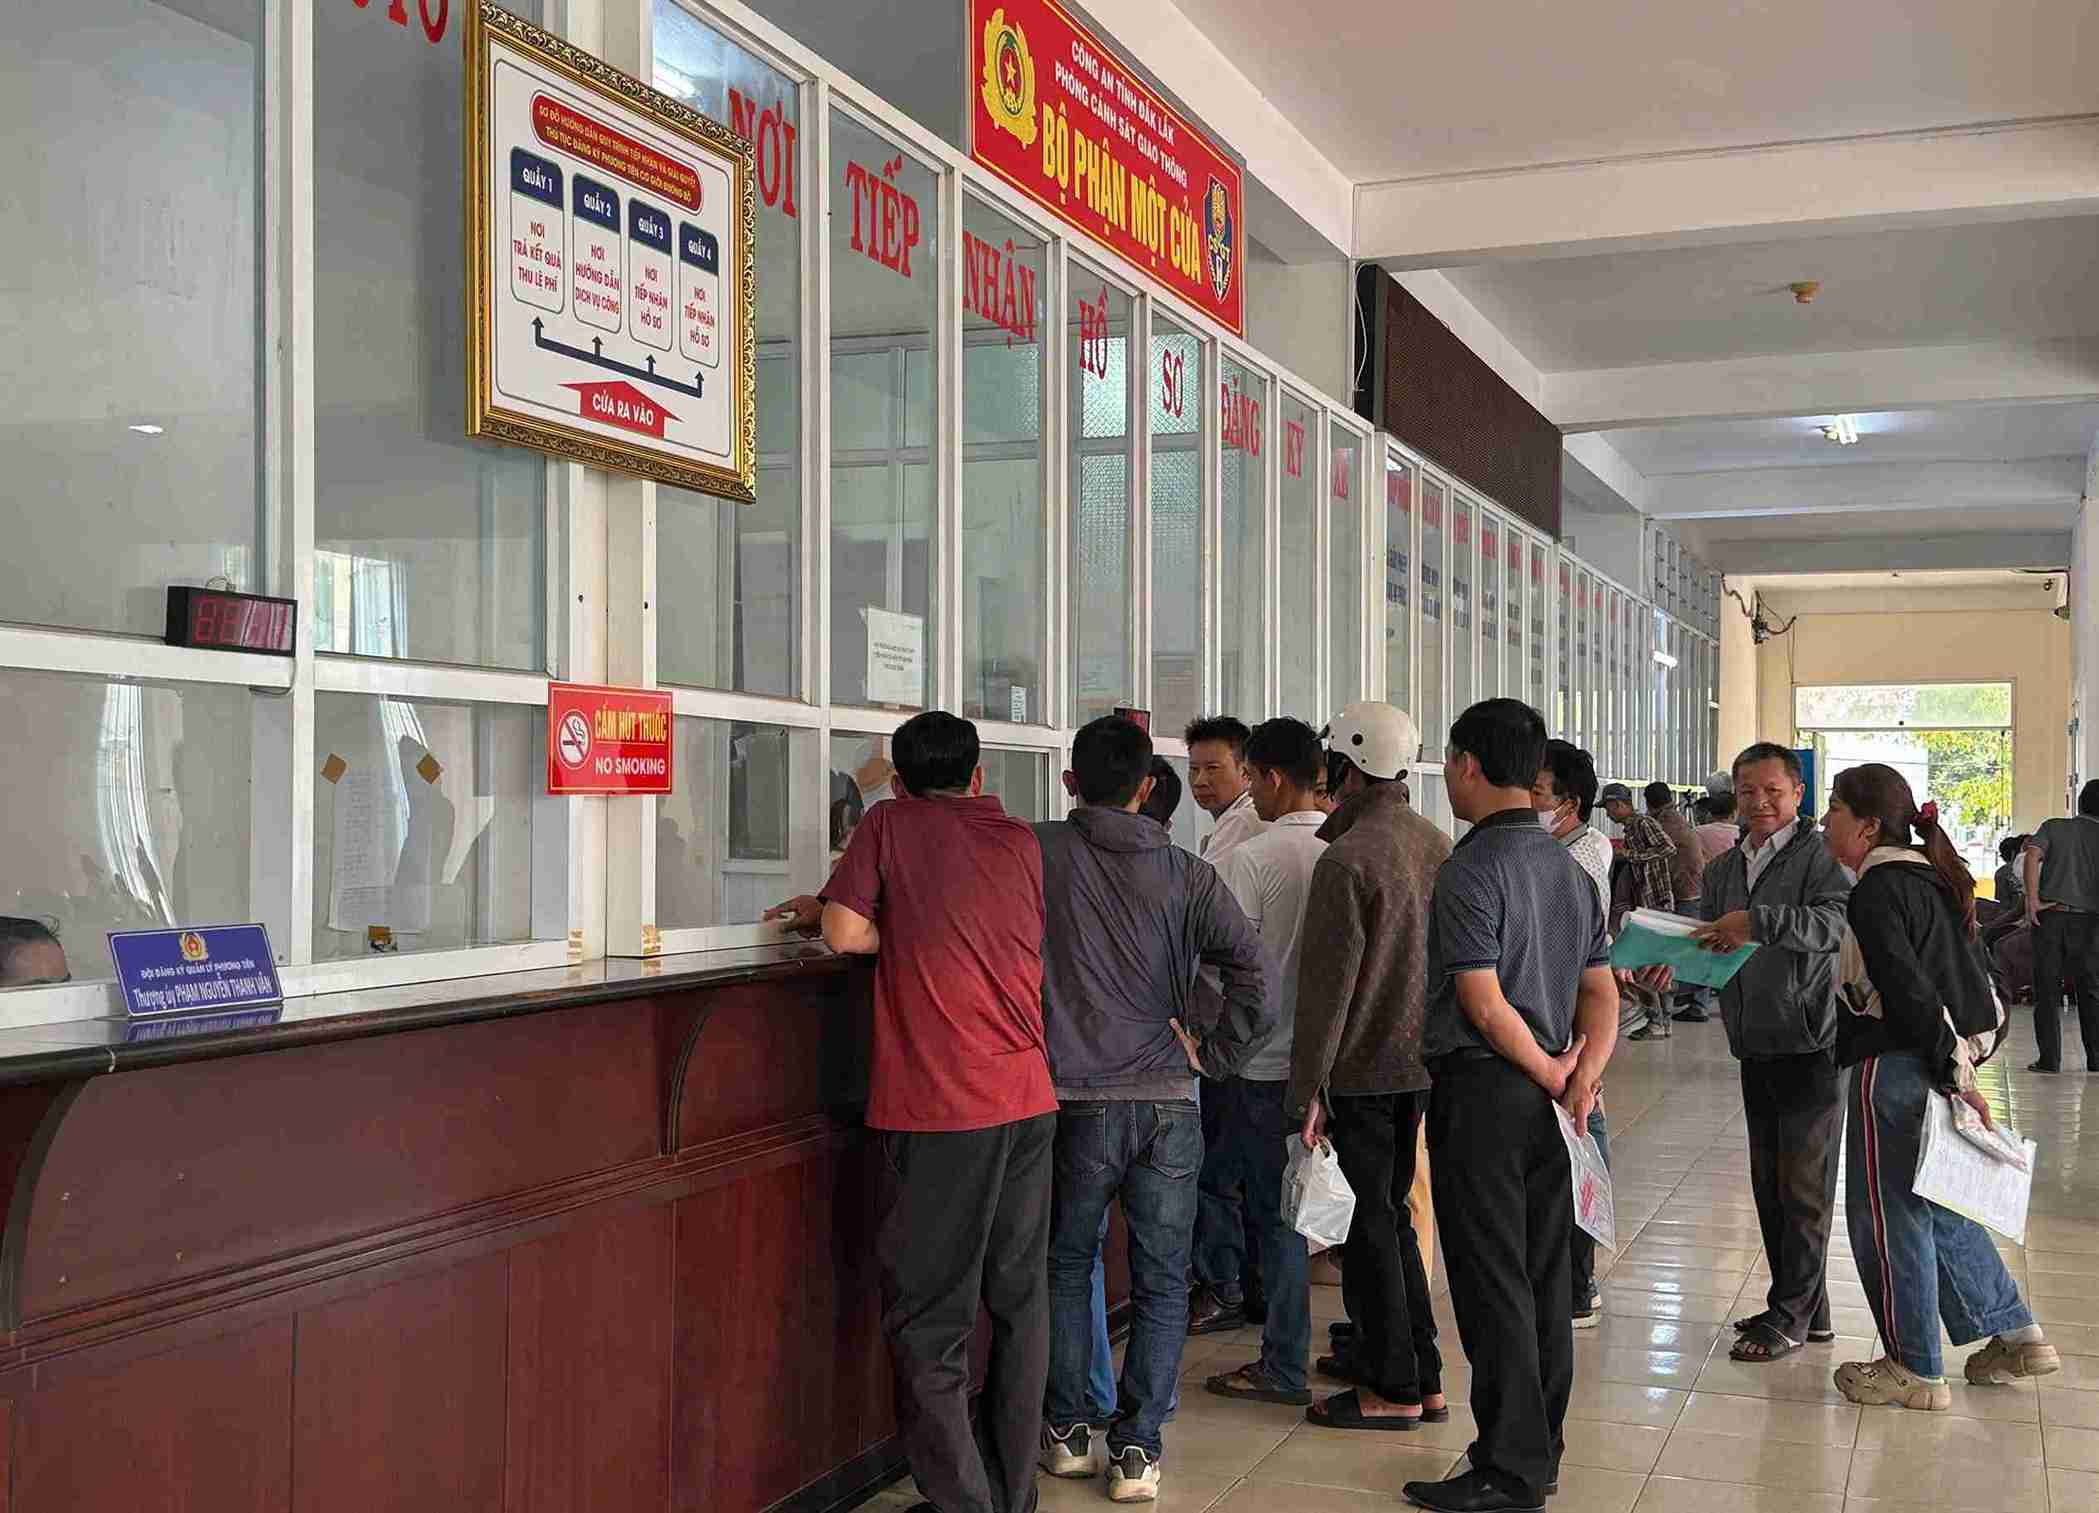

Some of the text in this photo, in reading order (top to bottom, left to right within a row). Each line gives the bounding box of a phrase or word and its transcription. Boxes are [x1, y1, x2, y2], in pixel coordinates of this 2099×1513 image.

[1071, 40, 1099, 81] CÔNG
[1100, 67, 1115, 94] AN
[1115, 77, 1137, 112] TỈNH
[1055, 60, 1089, 107] PHÒNG
[1090, 92, 1117, 130] CẢNH
[1118, 115, 1136, 147] SÁT
[1137, 132, 1159, 164] GIAO
[1159, 150, 1188, 189] THÔNG
[547, 178, 553, 193] 1
[1042, 100, 1202, 286] BỘ PHẬN MỘT CỬA
[606, 205, 612, 218] 2
[530, 221, 545, 239] NƠI
[658, 226, 664, 240] 3
[513, 239, 528, 258] TRẢ
[529, 242, 543, 262] KẾT
[591, 244, 605, 261] NƠI
[706, 248, 712, 261] 4
[518, 266, 533, 284] THU
[847, 155, 920, 279] TIẾP
[962, 230, 1036, 350] NHẬN
[1078, 285, 1108, 379] HỒ
[1162, 348, 1184, 418] SƠ
[617, 399, 630, 421] RA
[632, 402, 654, 426] VÀO
[594, 697, 668, 743] CẤM HÚT THUỐC
[594, 757, 666, 776] NO SMOKING
[175, 981, 201, 1005] PHẠM
[200, 972, 231, 1001] NGUYỄN
[230, 976, 257, 998] THANH
